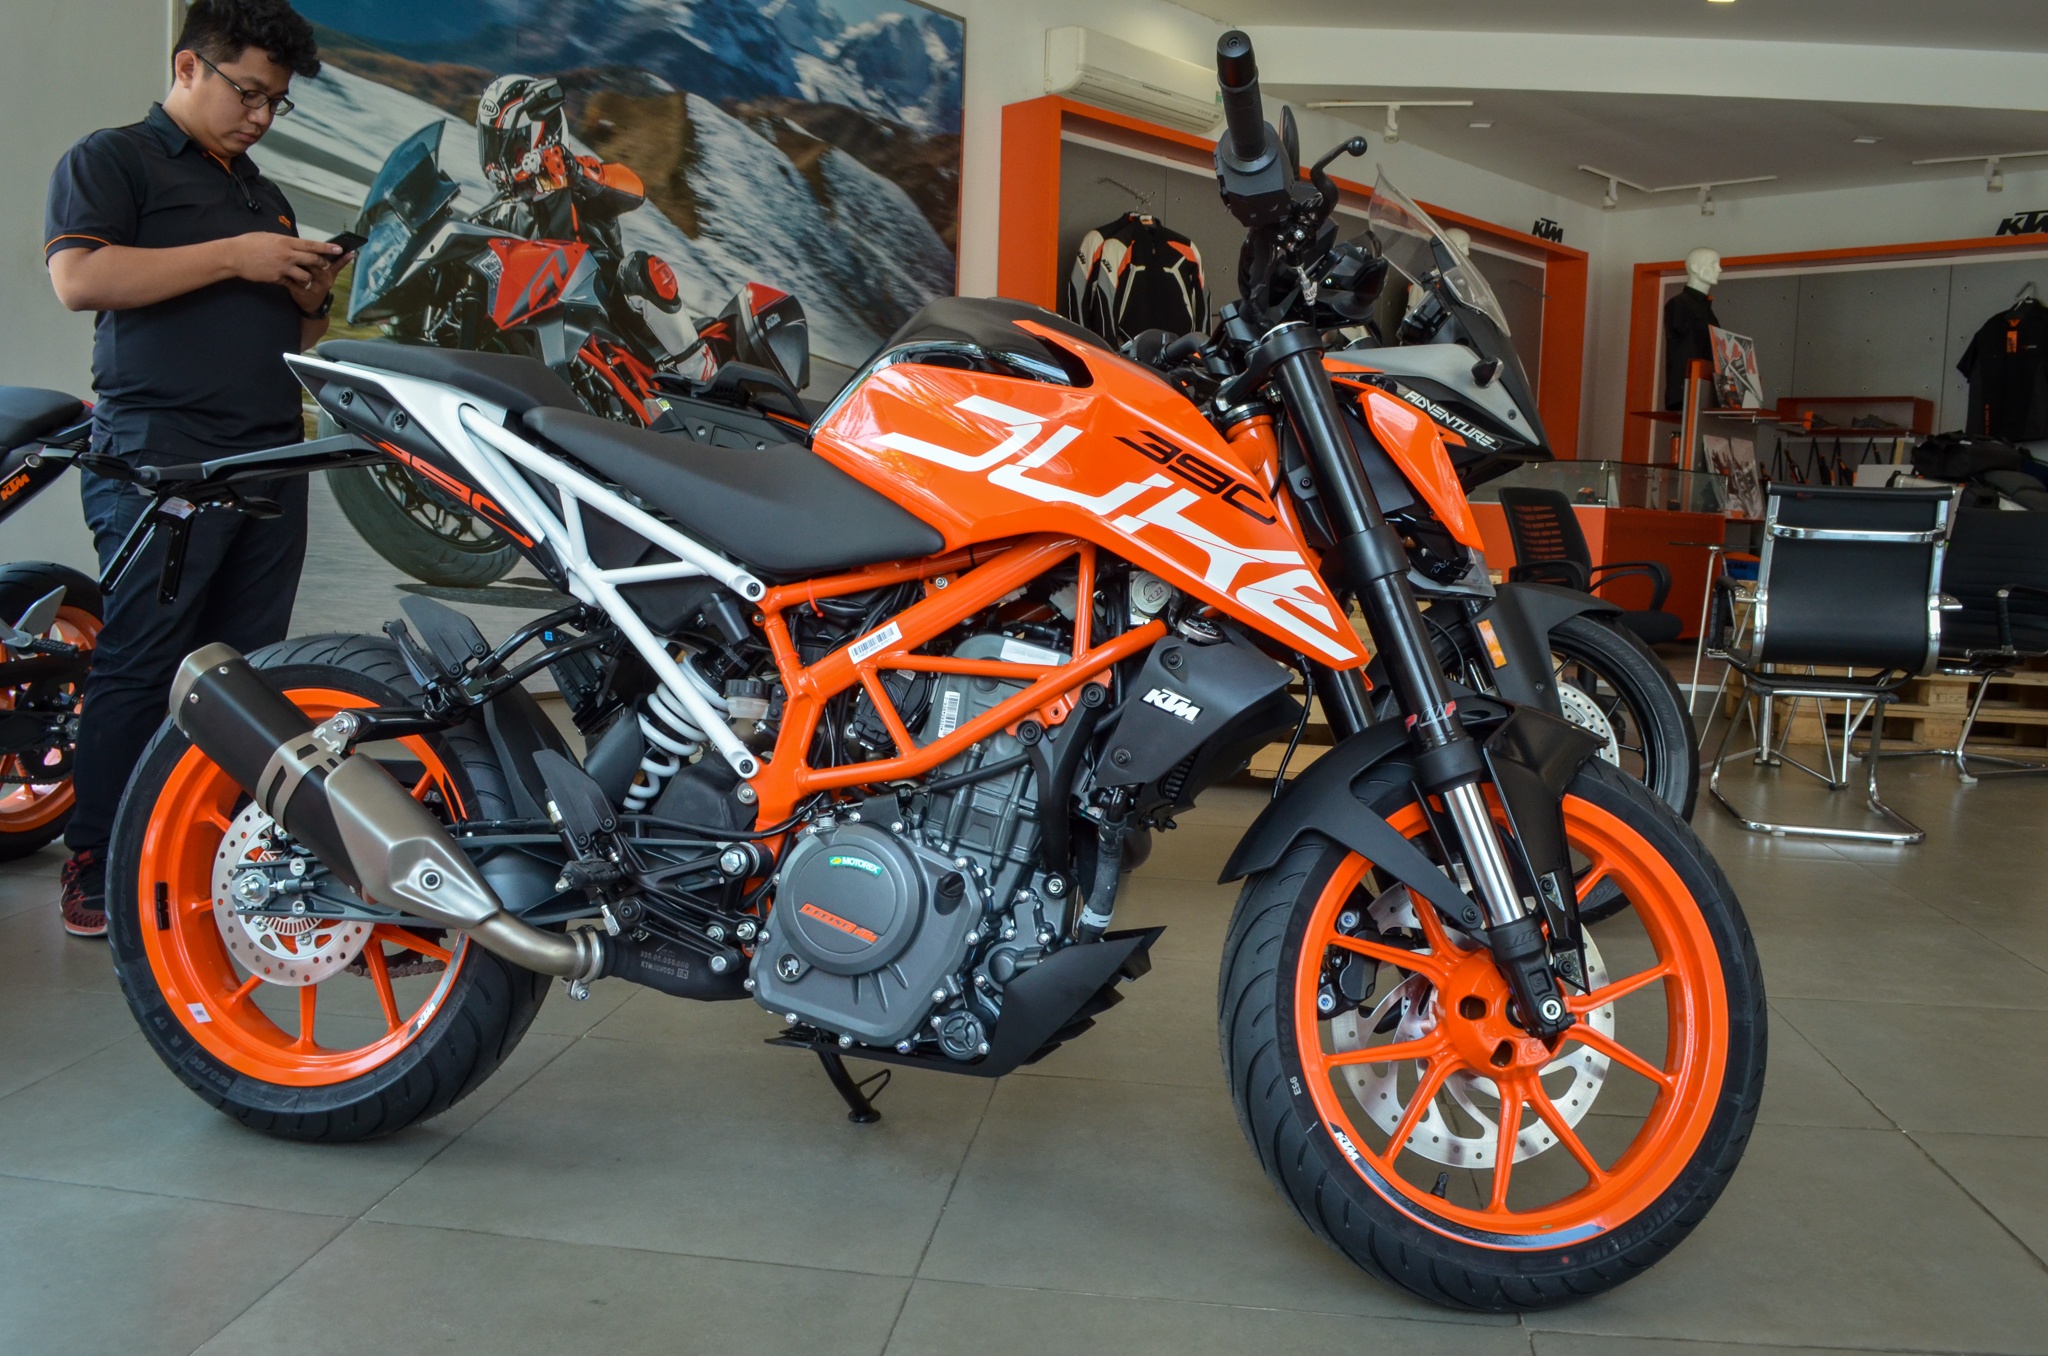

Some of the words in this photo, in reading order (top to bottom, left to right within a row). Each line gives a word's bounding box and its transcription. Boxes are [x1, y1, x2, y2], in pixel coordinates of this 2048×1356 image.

[1532, 217, 1564, 243] KTM
[1404, 390, 1497, 451] ADVENTURE
[0, 473, 31, 501] KTM
[1142, 688, 1201, 722] KTM
[842, 856, 882, 874] MOTOREX
[1334, 1131, 1360, 1161] KTM
[1584, 1196, 1680, 1264] MICHELIN
